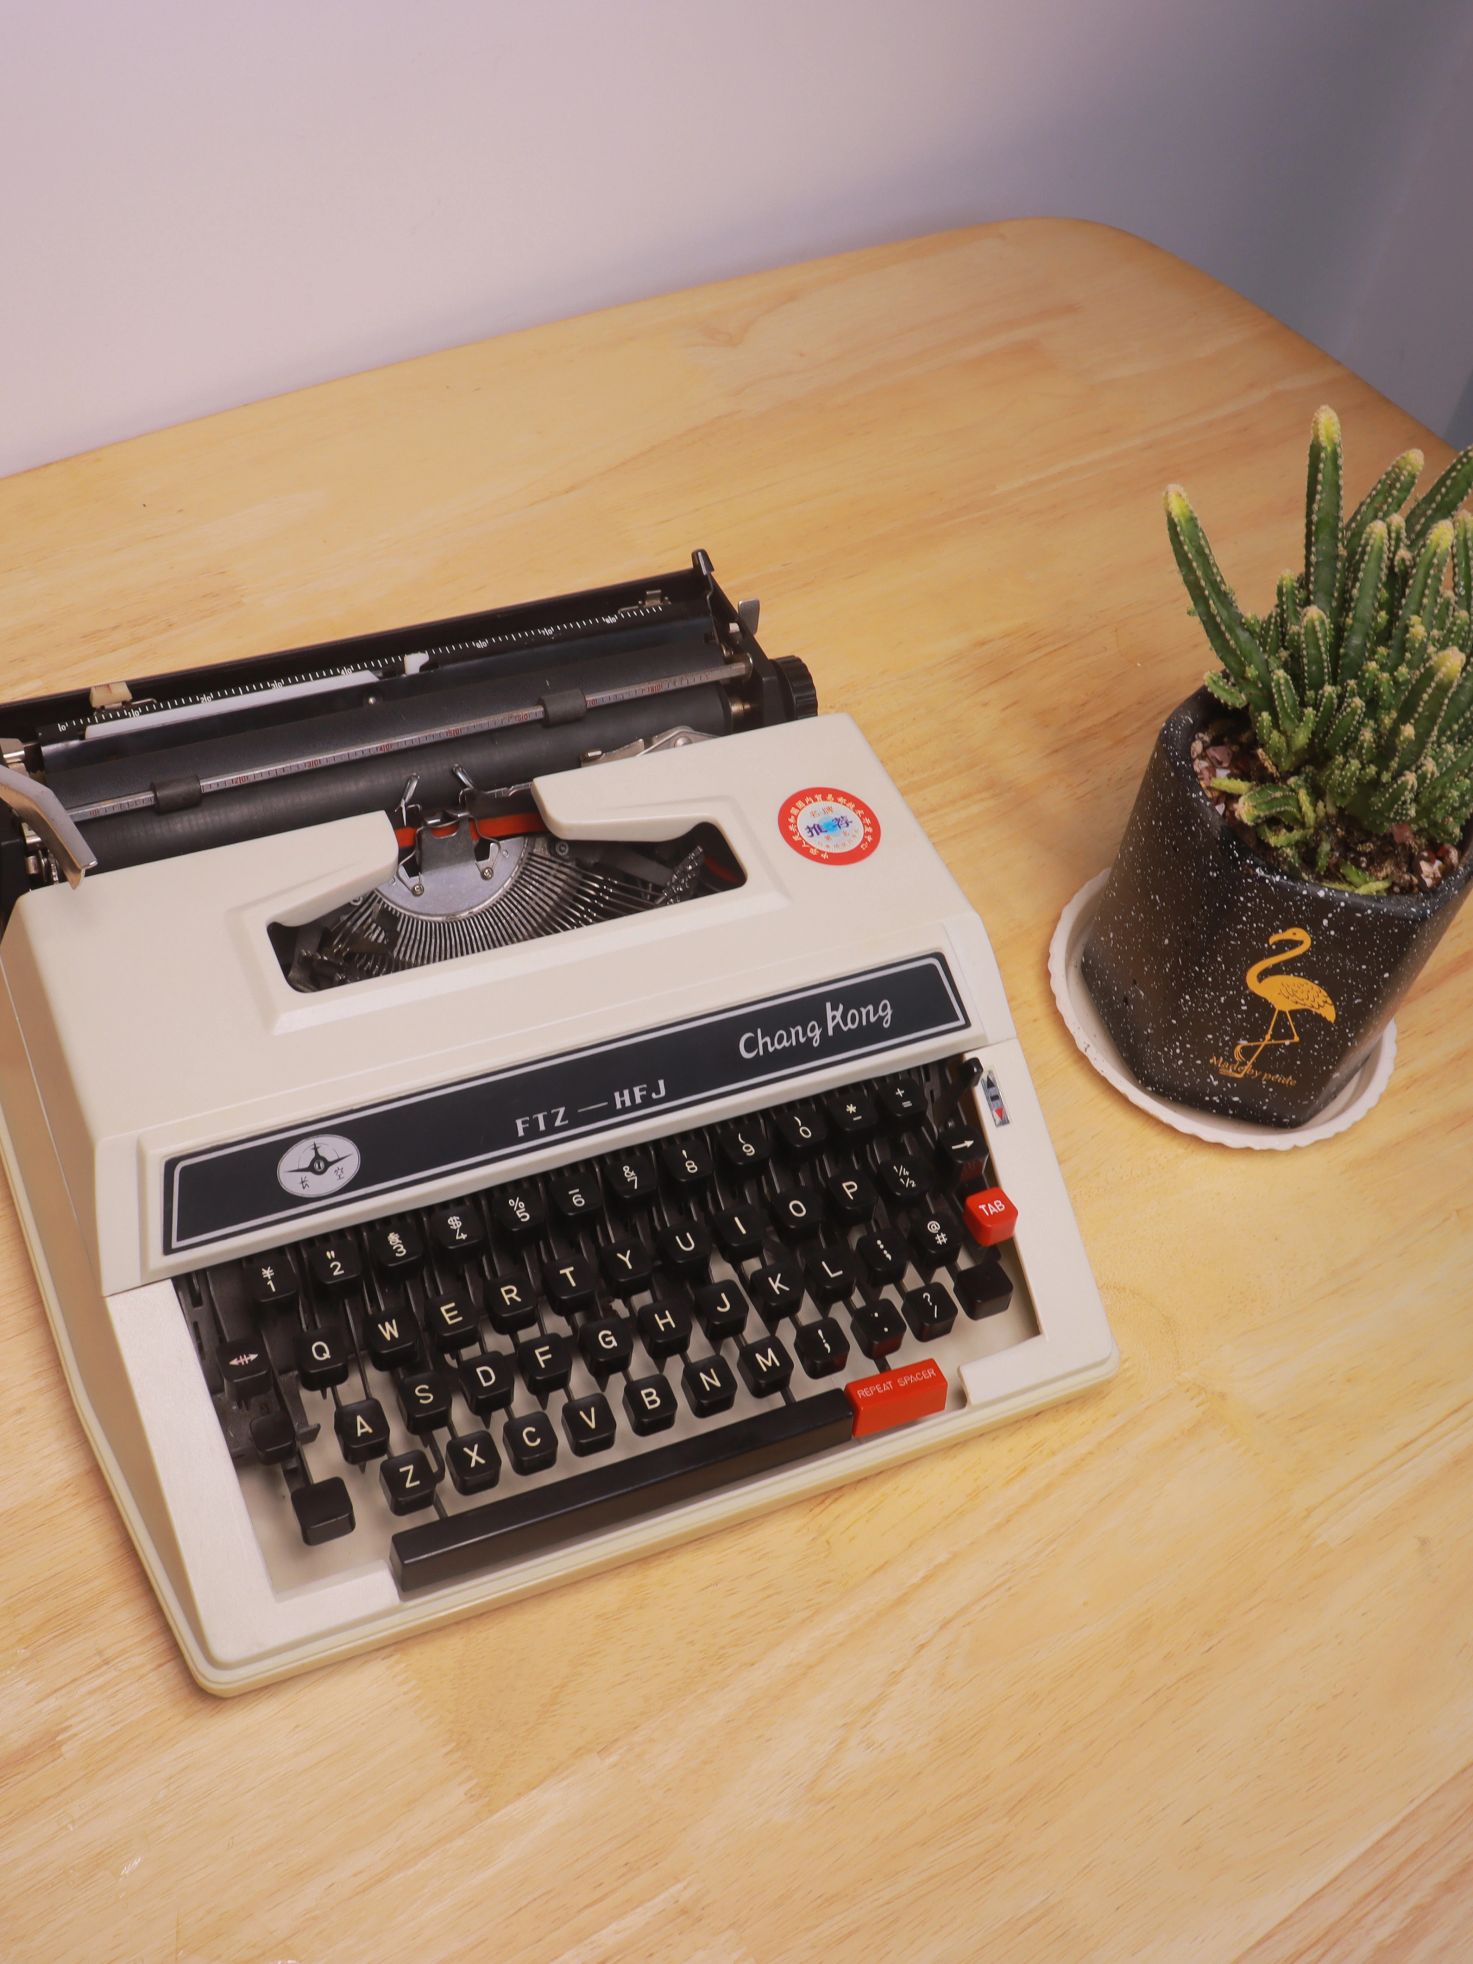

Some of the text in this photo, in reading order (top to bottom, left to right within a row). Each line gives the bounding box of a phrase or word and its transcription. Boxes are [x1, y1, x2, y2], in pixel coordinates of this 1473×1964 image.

[738, 999, 893, 1059] Chang Kong
[742, 1143, 755, 1156] 9
[623, 1165, 636, 1178] &
[685, 1160, 698, 1173] 8
[628, 1176, 638, 1190] 7
[842, 1182, 857, 1199] P
[508, 1196, 525, 1210] %
[572, 1194, 585, 1207] 6
[789, 1200, 806, 1217] O
[978, 1200, 1006, 1217] TAB
[448, 1216, 462, 1229] $
[516, 1207, 530, 1222] 5
[456, 1228, 468, 1240] 4
[735, 1217, 746, 1234] I
[927, 1220, 941, 1233] @
[676, 1233, 694, 1251] U
[935, 1232, 948, 1245] #
[393, 1244, 407, 1257] 3
[617, 1250, 632, 1269] Y
[262, 1266, 274, 1280] ¥
[330, 1261, 344, 1276] 2
[560, 1267, 575, 1286] T
[822, 1261, 842, 1277] L
[267, 1280, 276, 1292] 1
[768, 1274, 789, 1294] K
[501, 1286, 521, 1305] R
[717, 1293, 730, 1311] J
[923, 1292, 933, 1306] ?
[441, 1303, 462, 1324] E
[655, 1310, 675, 1331] H
[378, 1319, 398, 1340] W
[599, 1330, 617, 1348] G
[312, 1342, 330, 1360] Q
[535, 1346, 551, 1368] F
[756, 1348, 779, 1371] M
[476, 1366, 495, 1386] D
[700, 1369, 720, 1390] N
[856, 1368, 937, 1399] REPEAT SPACER
[415, 1385, 433, 1403] S
[641, 1388, 660, 1409] B
[357, 1415, 372, 1436] A
[580, 1407, 595, 1428] V
[523, 1427, 540, 1446] C
[464, 1444, 485, 1467] X
[400, 1465, 420, 1488] Z
